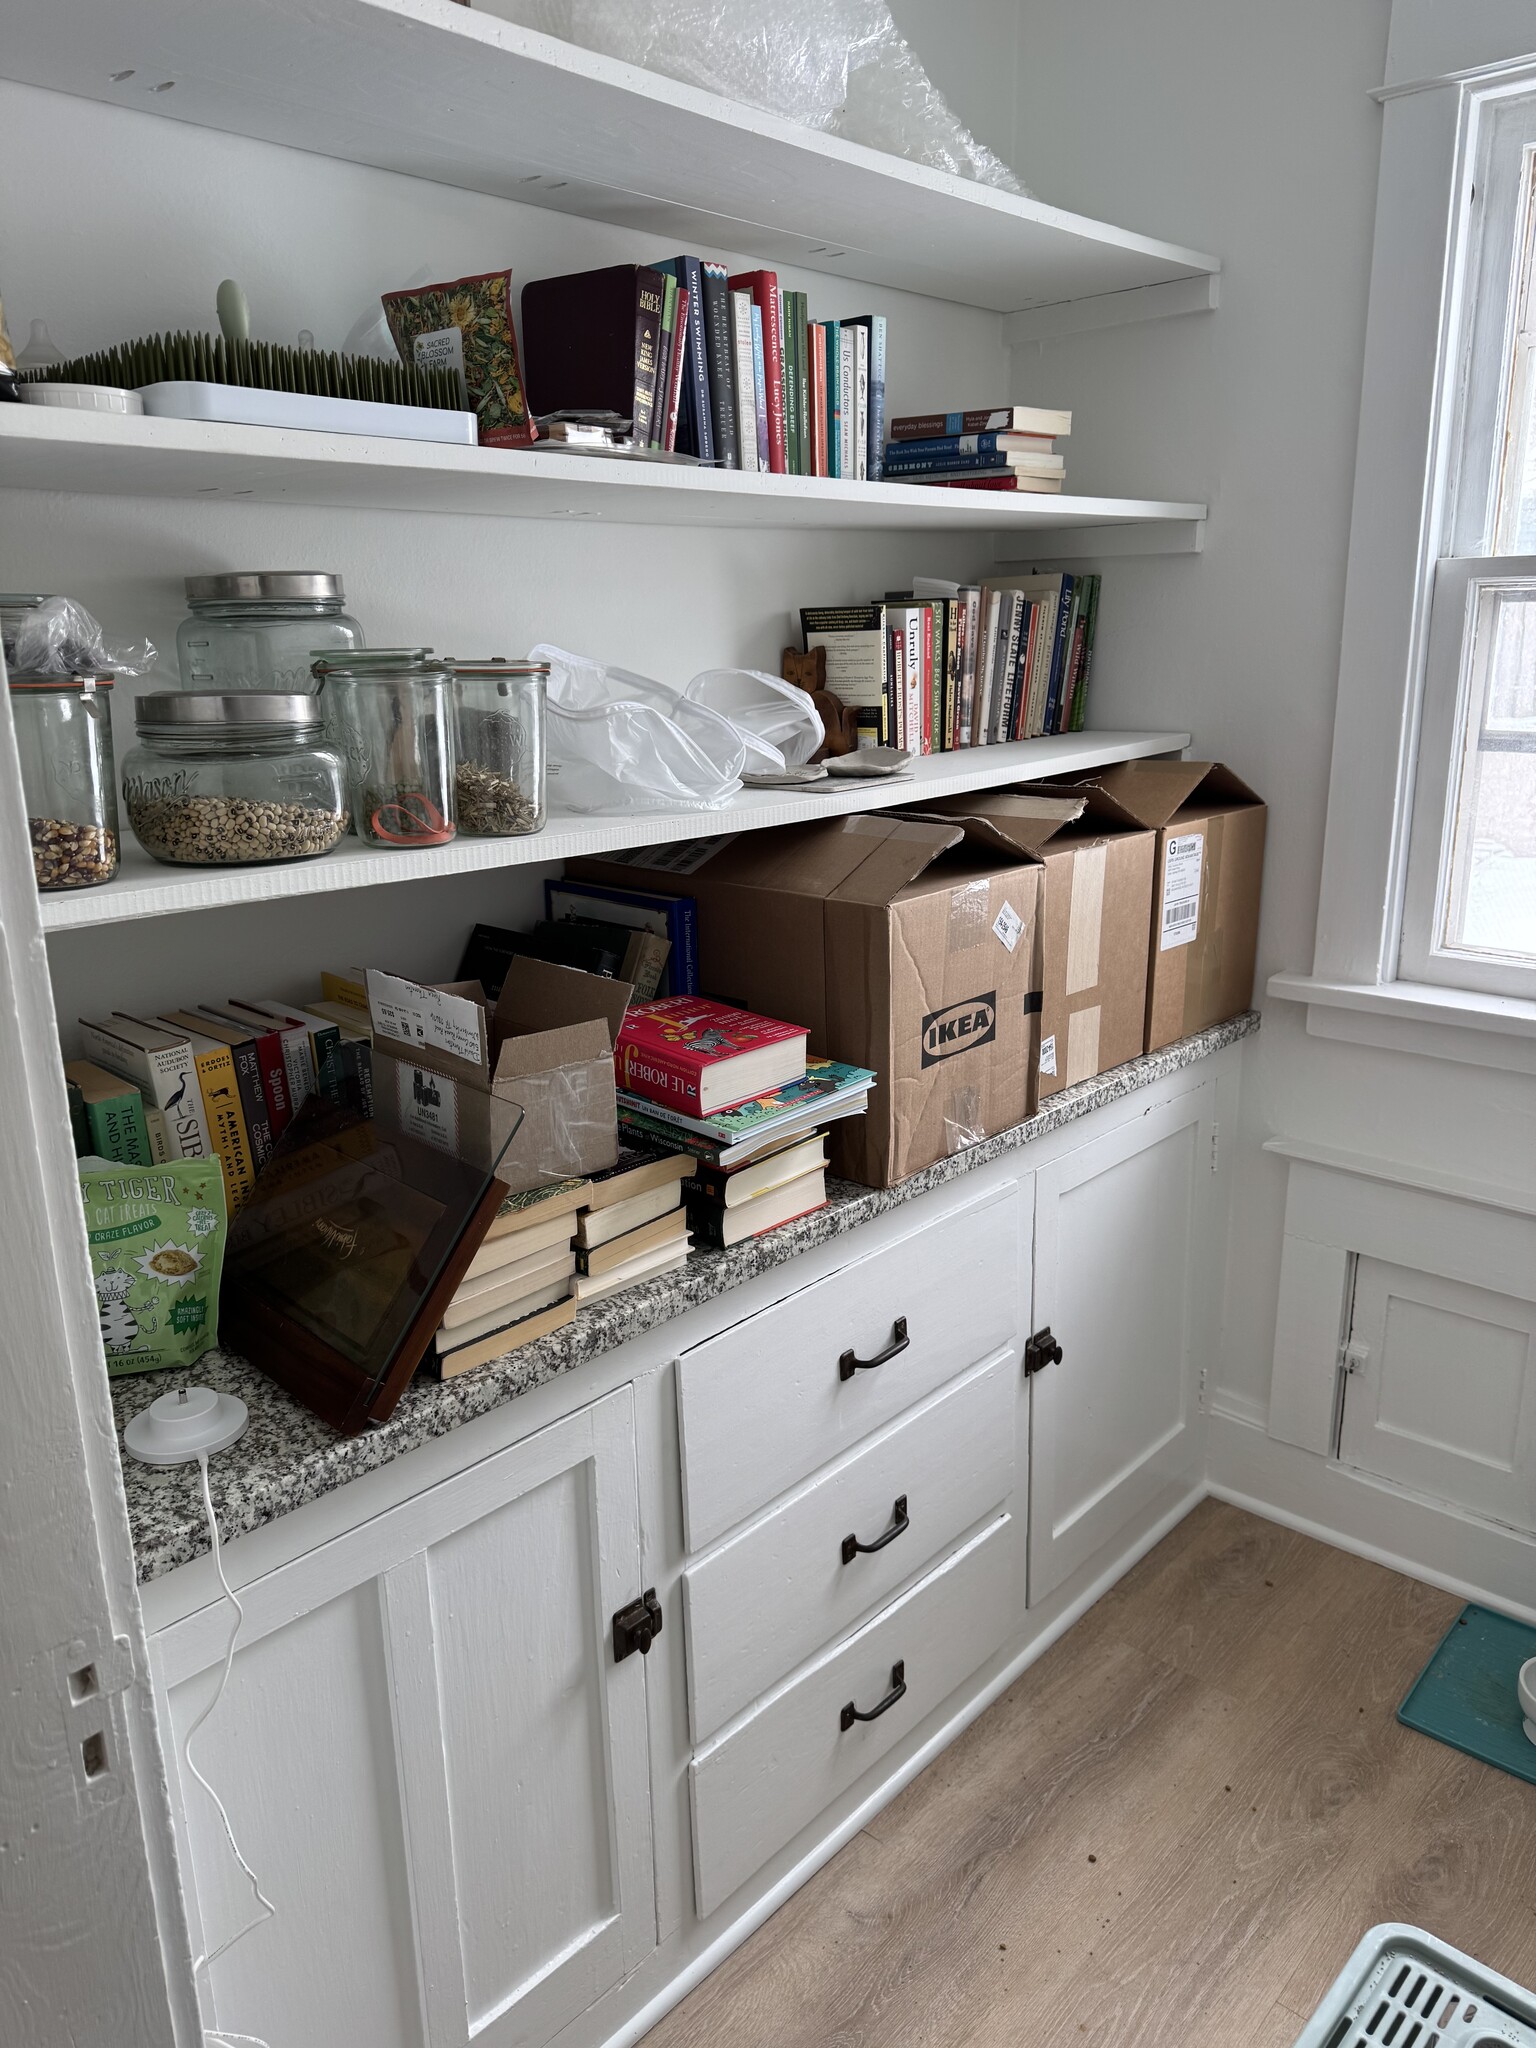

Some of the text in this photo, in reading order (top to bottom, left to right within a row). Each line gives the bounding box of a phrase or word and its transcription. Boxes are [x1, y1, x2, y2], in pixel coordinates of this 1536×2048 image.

[639, 299, 661, 313] BIBLE
[641, 290, 660, 302] HOLY
[689, 269, 705, 382] WINTER SWIMMING
[427, 337, 450, 349] SACRED
[641, 342, 653, 351] NEW
[712, 300, 723, 379] WOUNDED KNEE
[720, 315, 730, 371] HEARTBEAT
[422, 347, 454, 359] BLOSSOM
[430, 358, 447, 368] FARM
[640, 355, 653, 365] JAMES
[641, 348, 653, 358] KING
[842, 350, 850, 361] Us
[637, 361, 655, 374] VERSION
[767, 283, 784, 445] Matrescence Lucy Jones
[724, 377, 731, 389] OF
[842, 364, 851, 415] Conductors
[726, 405, 734, 435] DAVID
[893, 421, 917, 433] everyday
[918, 420, 943, 430] blessings
[887, 460, 932, 471] CEREMONY
[1012, 595, 1024, 632] JENNY
[1059, 588, 1072, 637] Lily Pond
[907, 617, 917, 670] Unruly
[1008, 634, 1019, 667] SLATE
[1001, 672, 1014, 727] LIFEFORM
[932, 690, 940, 733] SHATTUCK
[1170, 840, 1176, 855] G
[684, 910, 692, 923] The
[685, 924, 693, 963] International
[626, 998, 694, 1017] ROBERT
[929, 1008, 990, 1050] IKEA
[155, 1048, 188, 1060] NATIONAL
[157, 1055, 189, 1067] AUDUBON
[201, 1055, 230, 1068] ERDOES
[159, 1061, 189, 1074] SOCIETY
[208, 1061, 230, 1072] ORTIZ
[239, 1055, 250, 1076] FOX
[282, 1038, 299, 1111] CHRISTOPHER MURRA
[293, 1059, 302, 1091] VICTORIA
[325, 1039, 339, 1100] CHRIST THE
[247, 1052, 263, 1102] MATTHEW
[671, 1075, 684, 1094] LE
[268, 1068, 286, 1110] Spoon
[364, 1068, 374, 1118] REDEMPTION
[187, 1099, 195, 1114] THE
[418, 1106, 438, 1122] UN3481
[650, 1107, 659, 1116] BAIN
[660, 1111, 666, 1119] DE
[106, 1112, 120, 1143] AND
[121, 1106, 136, 1134] THE
[261, 1120, 270, 1141] THE
[155, 1132, 165, 1157] BIRDS
[217, 1114, 234, 1177] MYTHS AND
[226, 1111, 246, 1175] AMERICAN
[252, 1123, 266, 1164] COSMIC
[622, 1124, 683, 1152] Plants Wisconsin
[100, 1176, 182, 1207] TIGER
[95, 1203, 158, 1226] CAT TREATS
[94, 1219, 155, 1242] CRAZE FLAVOR
[195, 1223, 211, 1231] TREAT
[177, 1306, 204, 1315] AMAZINGLY
[177, 1316, 189, 1324] SOFT
[137, 1353, 162, 1365] (454g)
